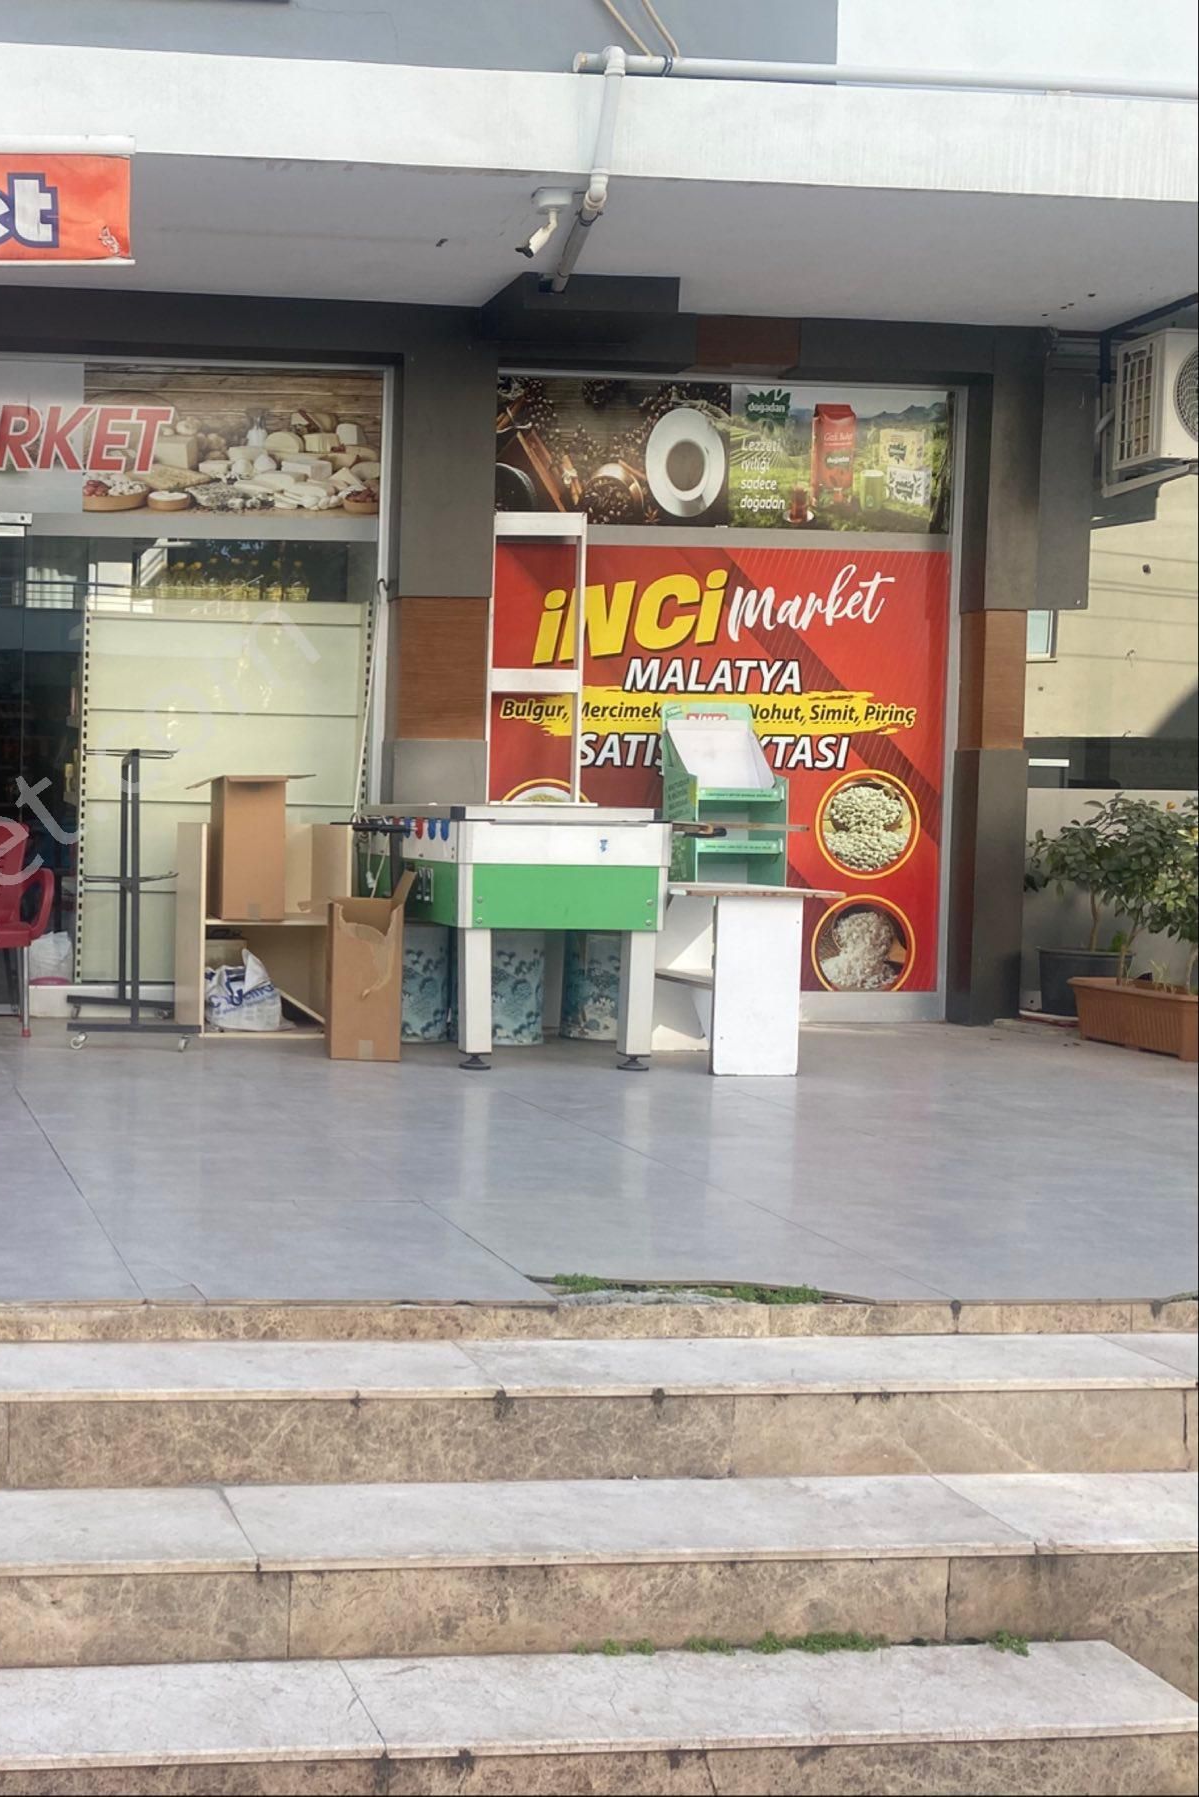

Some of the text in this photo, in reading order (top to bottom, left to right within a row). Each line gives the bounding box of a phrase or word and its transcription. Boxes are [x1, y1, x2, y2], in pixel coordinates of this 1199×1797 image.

[740, 479, 778, 491] sadece
[740, 495, 786, 512] doğadan
[727, 563, 895, 643] Market
[623, 657, 803, 693] MALATYA
[502, 701, 569, 722] Bulgur,
[810, 704, 860, 722] Simit,
[864, 705, 916, 725] Pirinç
